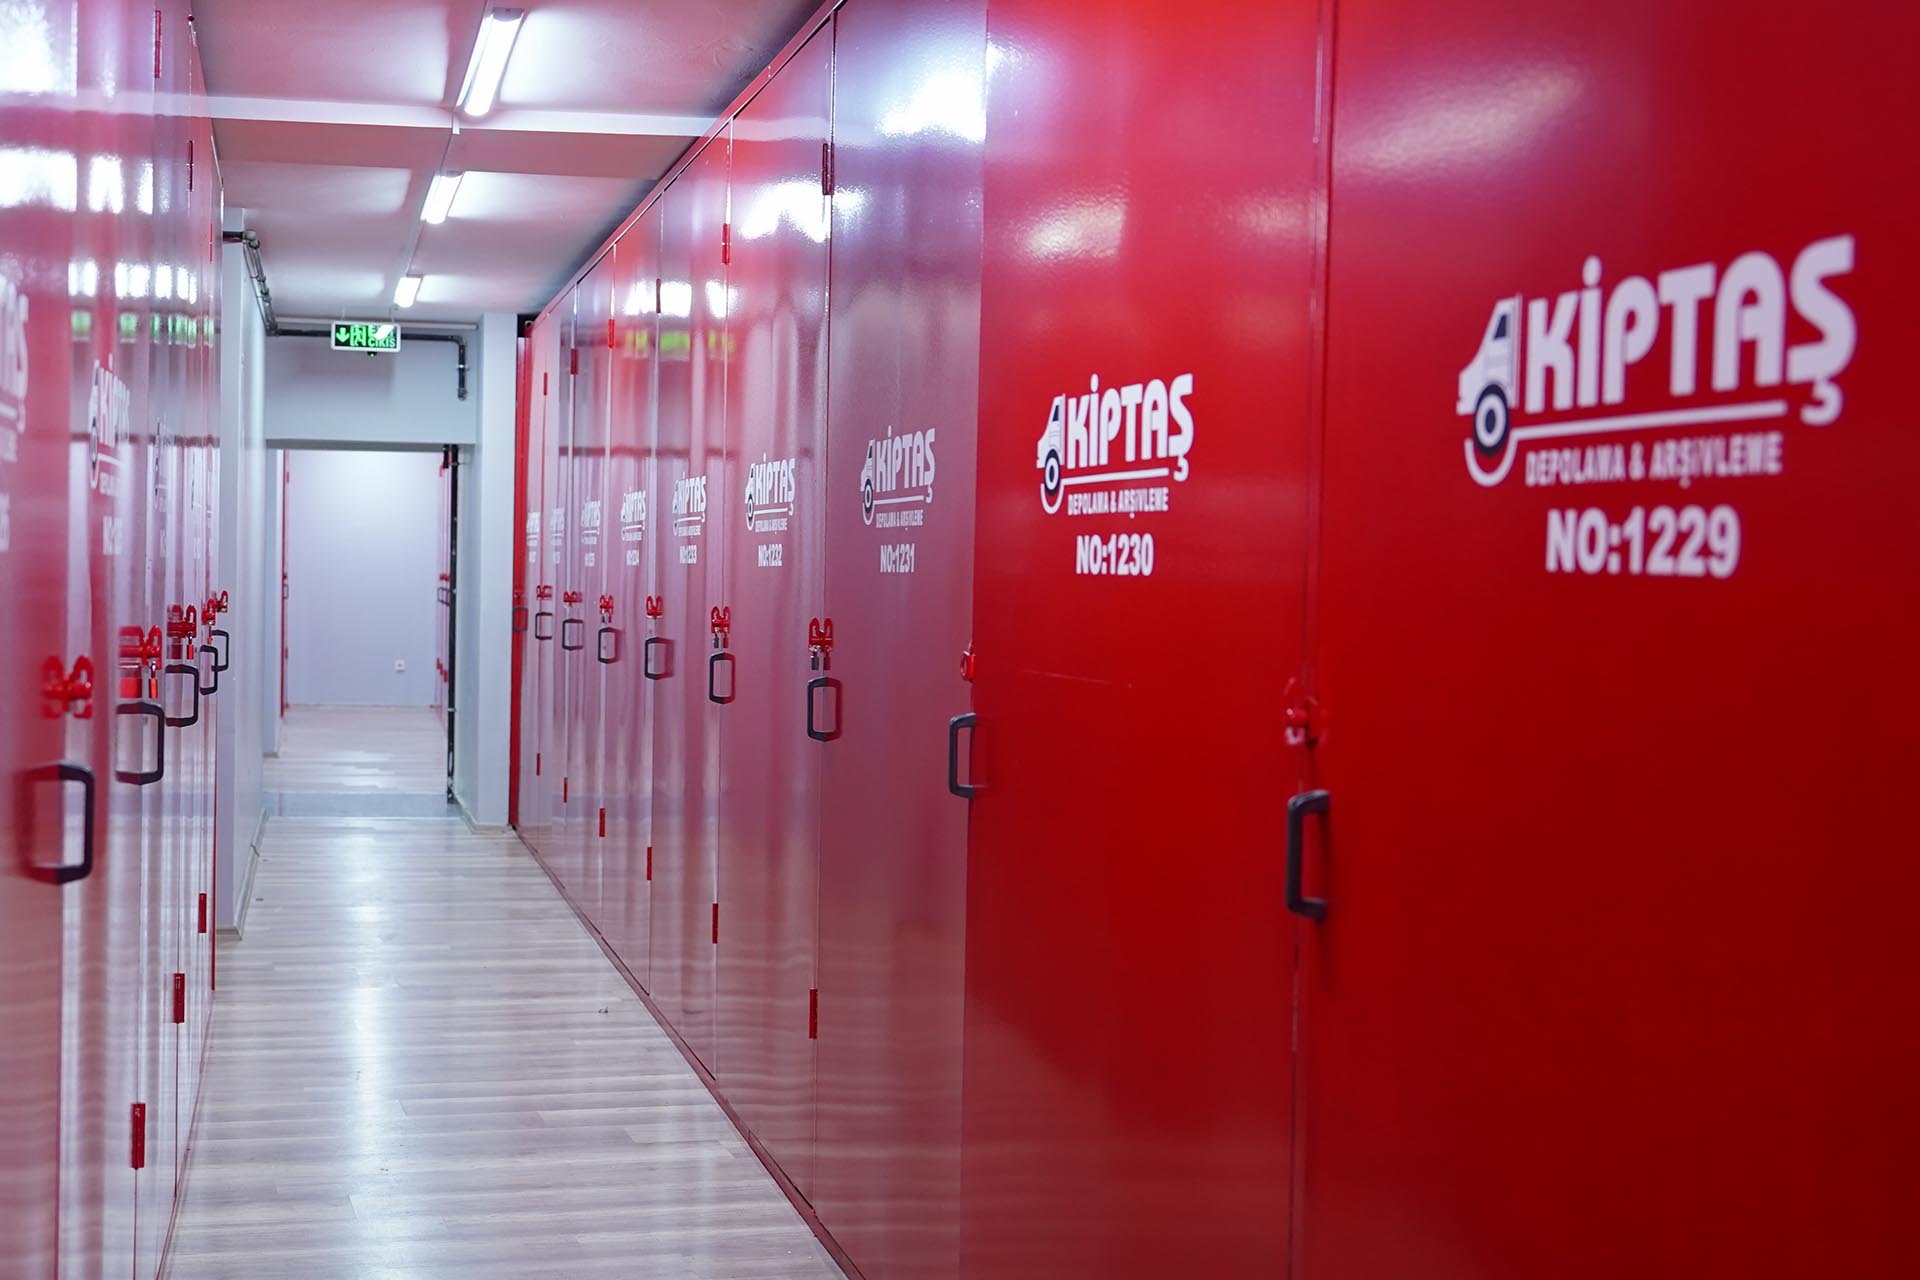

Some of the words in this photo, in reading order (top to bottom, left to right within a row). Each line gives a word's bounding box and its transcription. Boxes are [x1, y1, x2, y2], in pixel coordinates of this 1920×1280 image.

[1525, 234, 1857, 425] KİPTAŞ
[1067, 373, 1194, 481] KİPTAŞ
[755, 452, 795, 516] KİPTAŞ
[876, 425, 935, 504] KİPTAŞ
[1525, 444, 1625, 487] DEPOLAMA
[1629, 441, 1645, 481] &
[1067, 491, 1110, 516] DEPOLAMA
[880, 543, 915, 573] NO:1231
[1075, 533, 1154, 576] NO:1230
[1545, 504, 1742, 579] NO:1229
